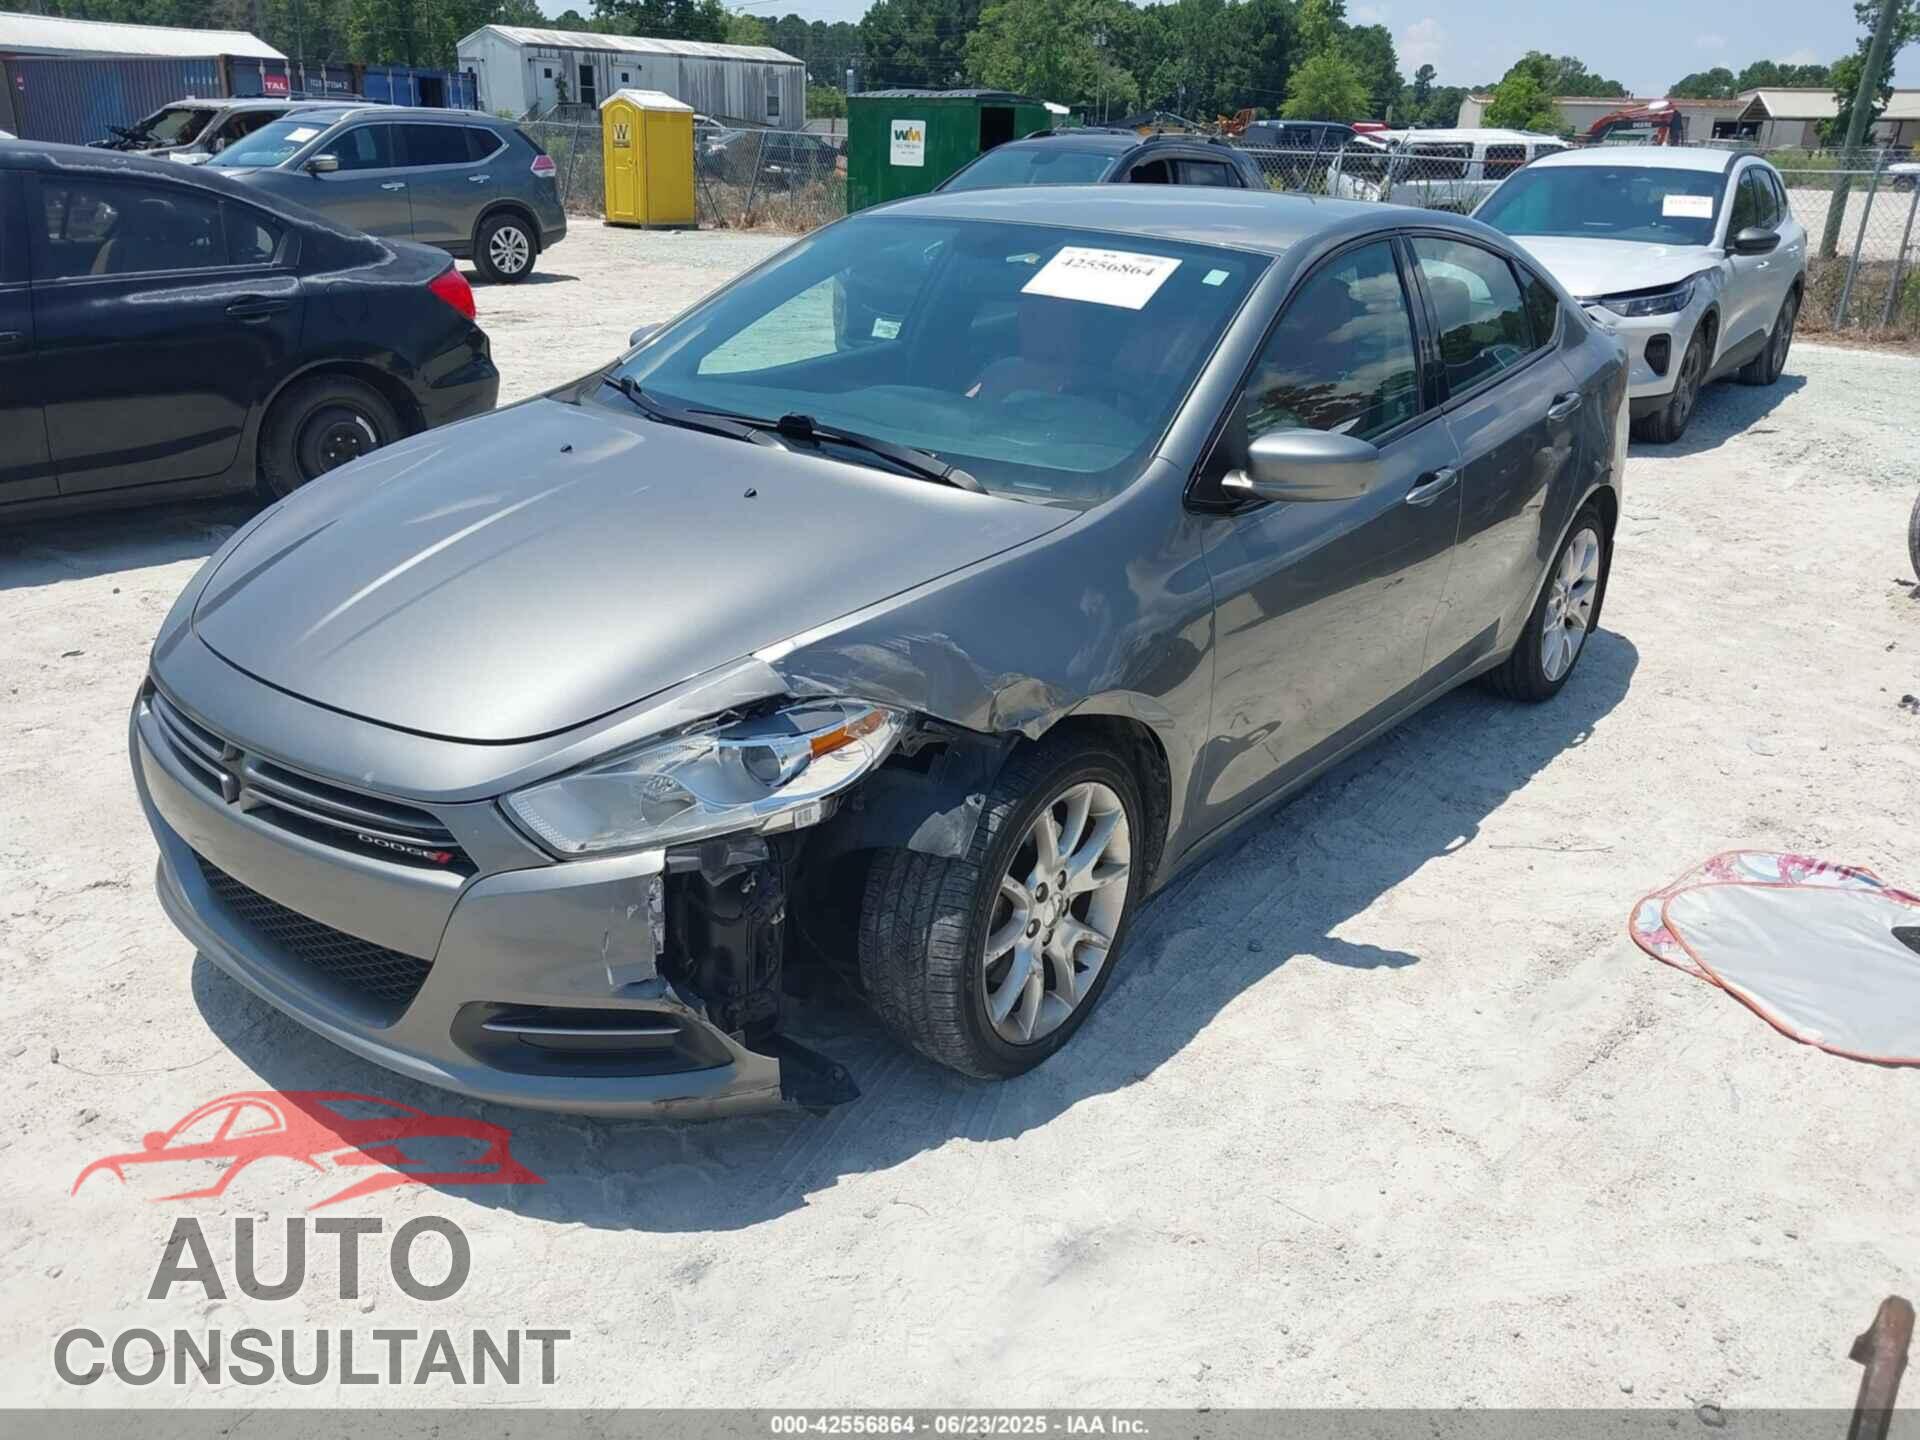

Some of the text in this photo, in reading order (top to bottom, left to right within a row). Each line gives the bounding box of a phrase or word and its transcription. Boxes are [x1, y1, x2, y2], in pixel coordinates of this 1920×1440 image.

[265, 81, 287, 90] TAL
[614, 124, 629, 139] W
[894, 126, 921, 141] WM
[1061, 256, 1156, 277] 42556864
[357, 833, 437, 861] DODGE
